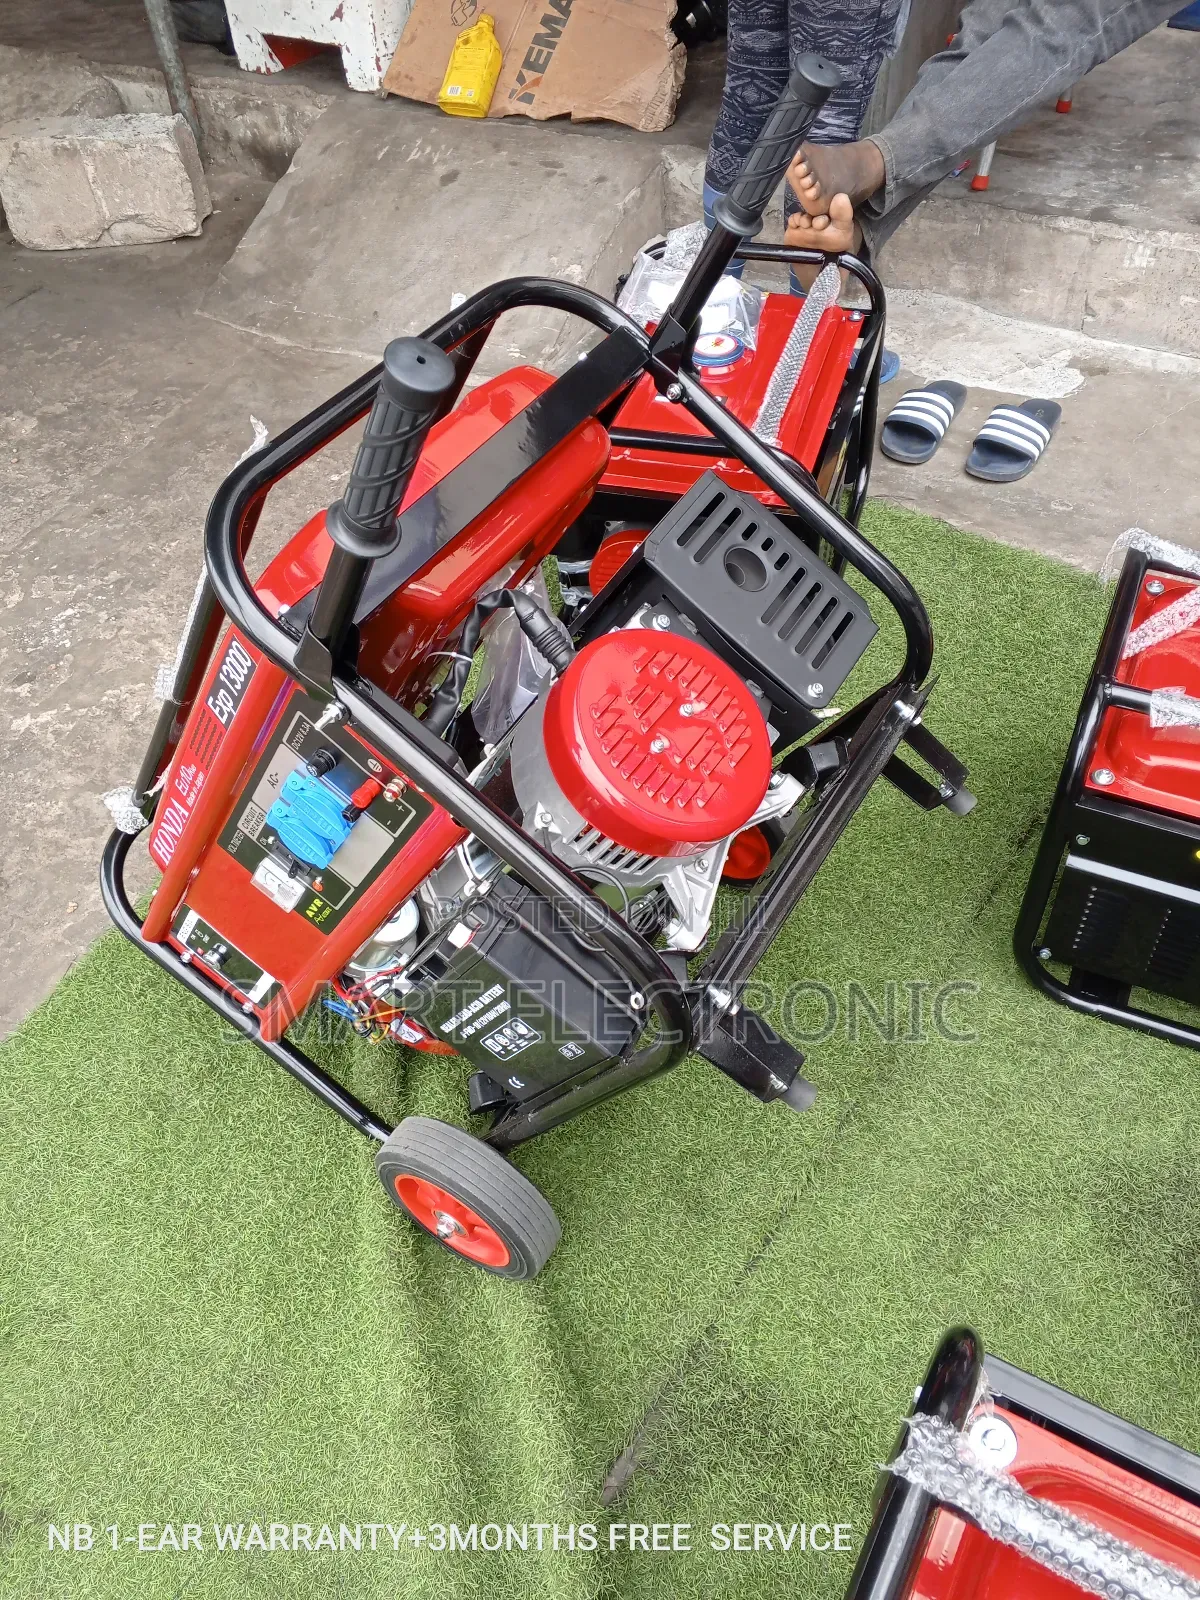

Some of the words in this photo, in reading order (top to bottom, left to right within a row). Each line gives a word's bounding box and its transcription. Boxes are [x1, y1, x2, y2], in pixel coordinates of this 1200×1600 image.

[219, 640, 252, 697] 13000
[207, 688, 236, 724] Exp
[153, 796, 189, 866] HONDA
[241, 806, 258, 831] CIRCUIT
[248, 812, 265, 838] BREAKER
[305, 898, 324, 918] AVR
[478, 983, 505, 1005] BATTERY
